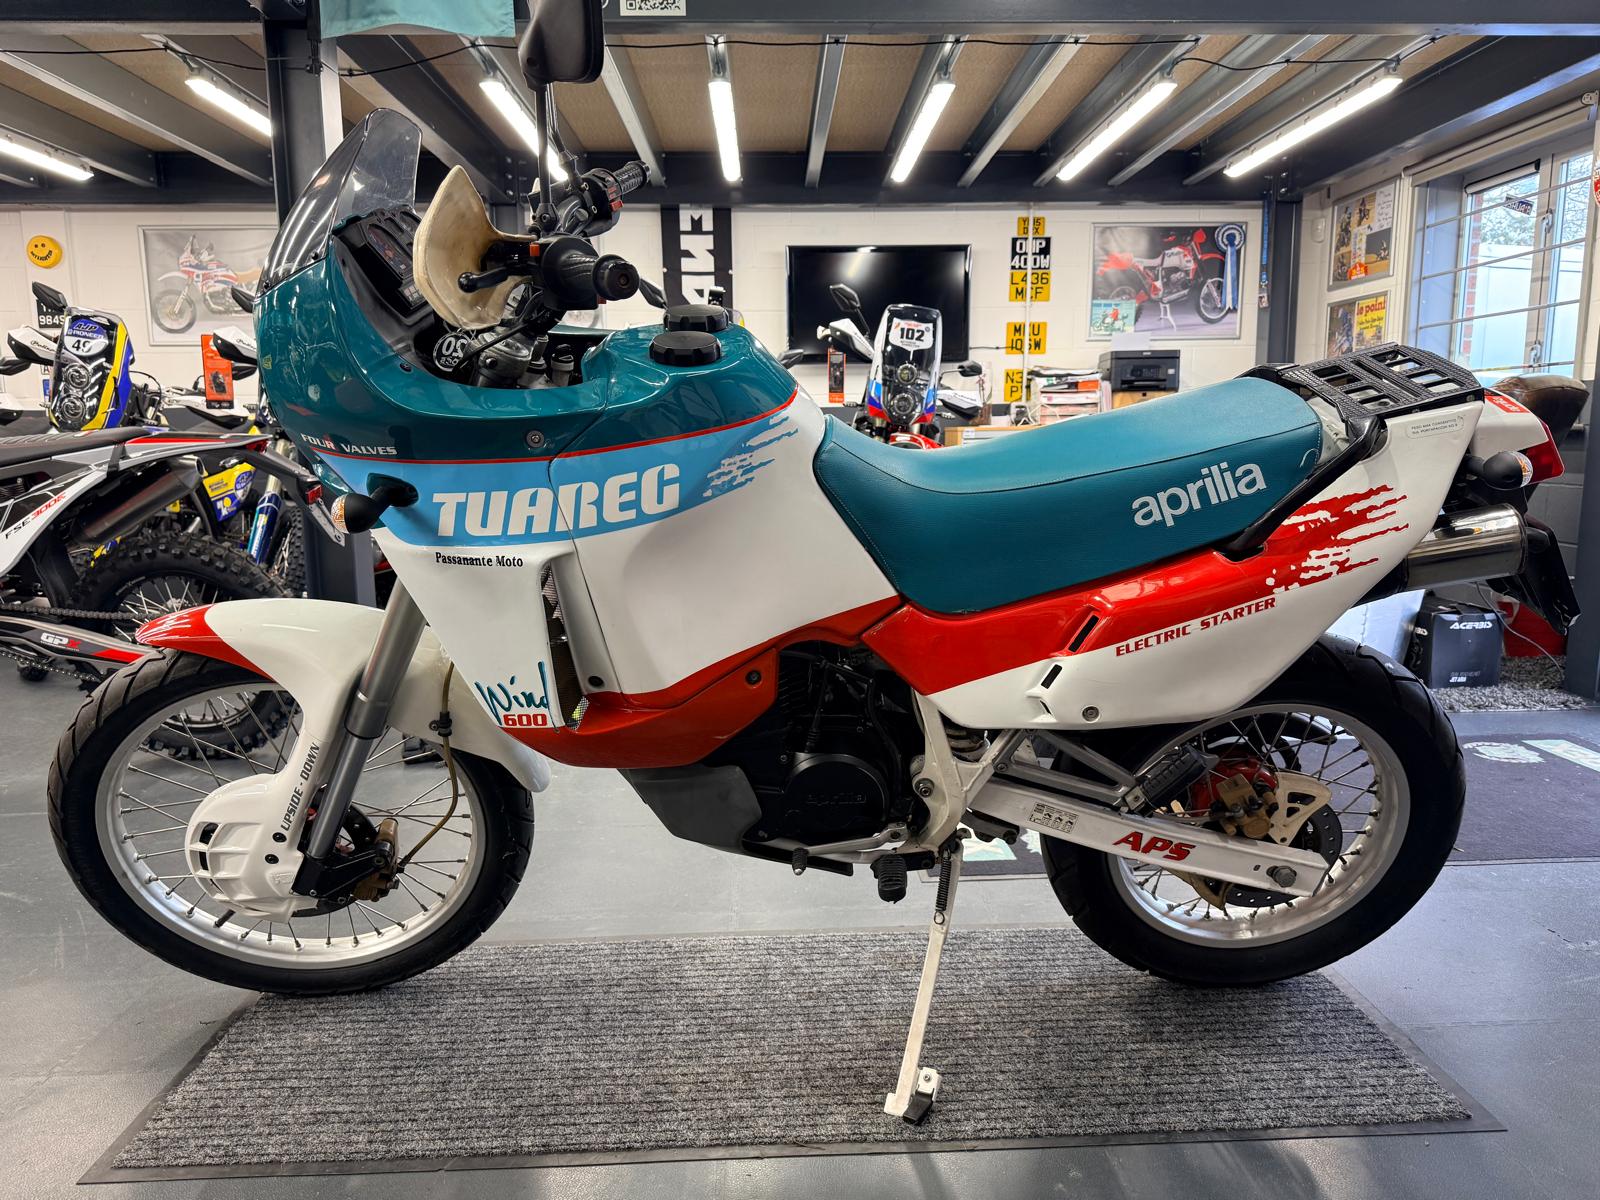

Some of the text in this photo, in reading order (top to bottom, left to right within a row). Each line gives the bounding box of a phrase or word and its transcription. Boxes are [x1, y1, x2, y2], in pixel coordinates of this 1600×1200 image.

[74, 322, 99, 331] AJP
[900, 327, 925, 342] 102
[72, 339, 93, 354] 49
[300, 433, 398, 455] FOUR VALVES
[432, 463, 680, 537] TUAREG
[1131, 461, 1267, 527] aprilia
[5, 516, 30, 540] FSE
[435, 551, 524, 567] Passanante Moto
[1115, 597, 1276, 657] ELECTRIC STARTER
[40, 632, 81, 649] GPX
[474, 660, 556, 731] Wind
[503, 713, 547, 727] 600
[280, 786, 303, 832] UPSIDE
[300, 742, 320, 780] DOWN
[1113, 831, 1197, 861] APS
